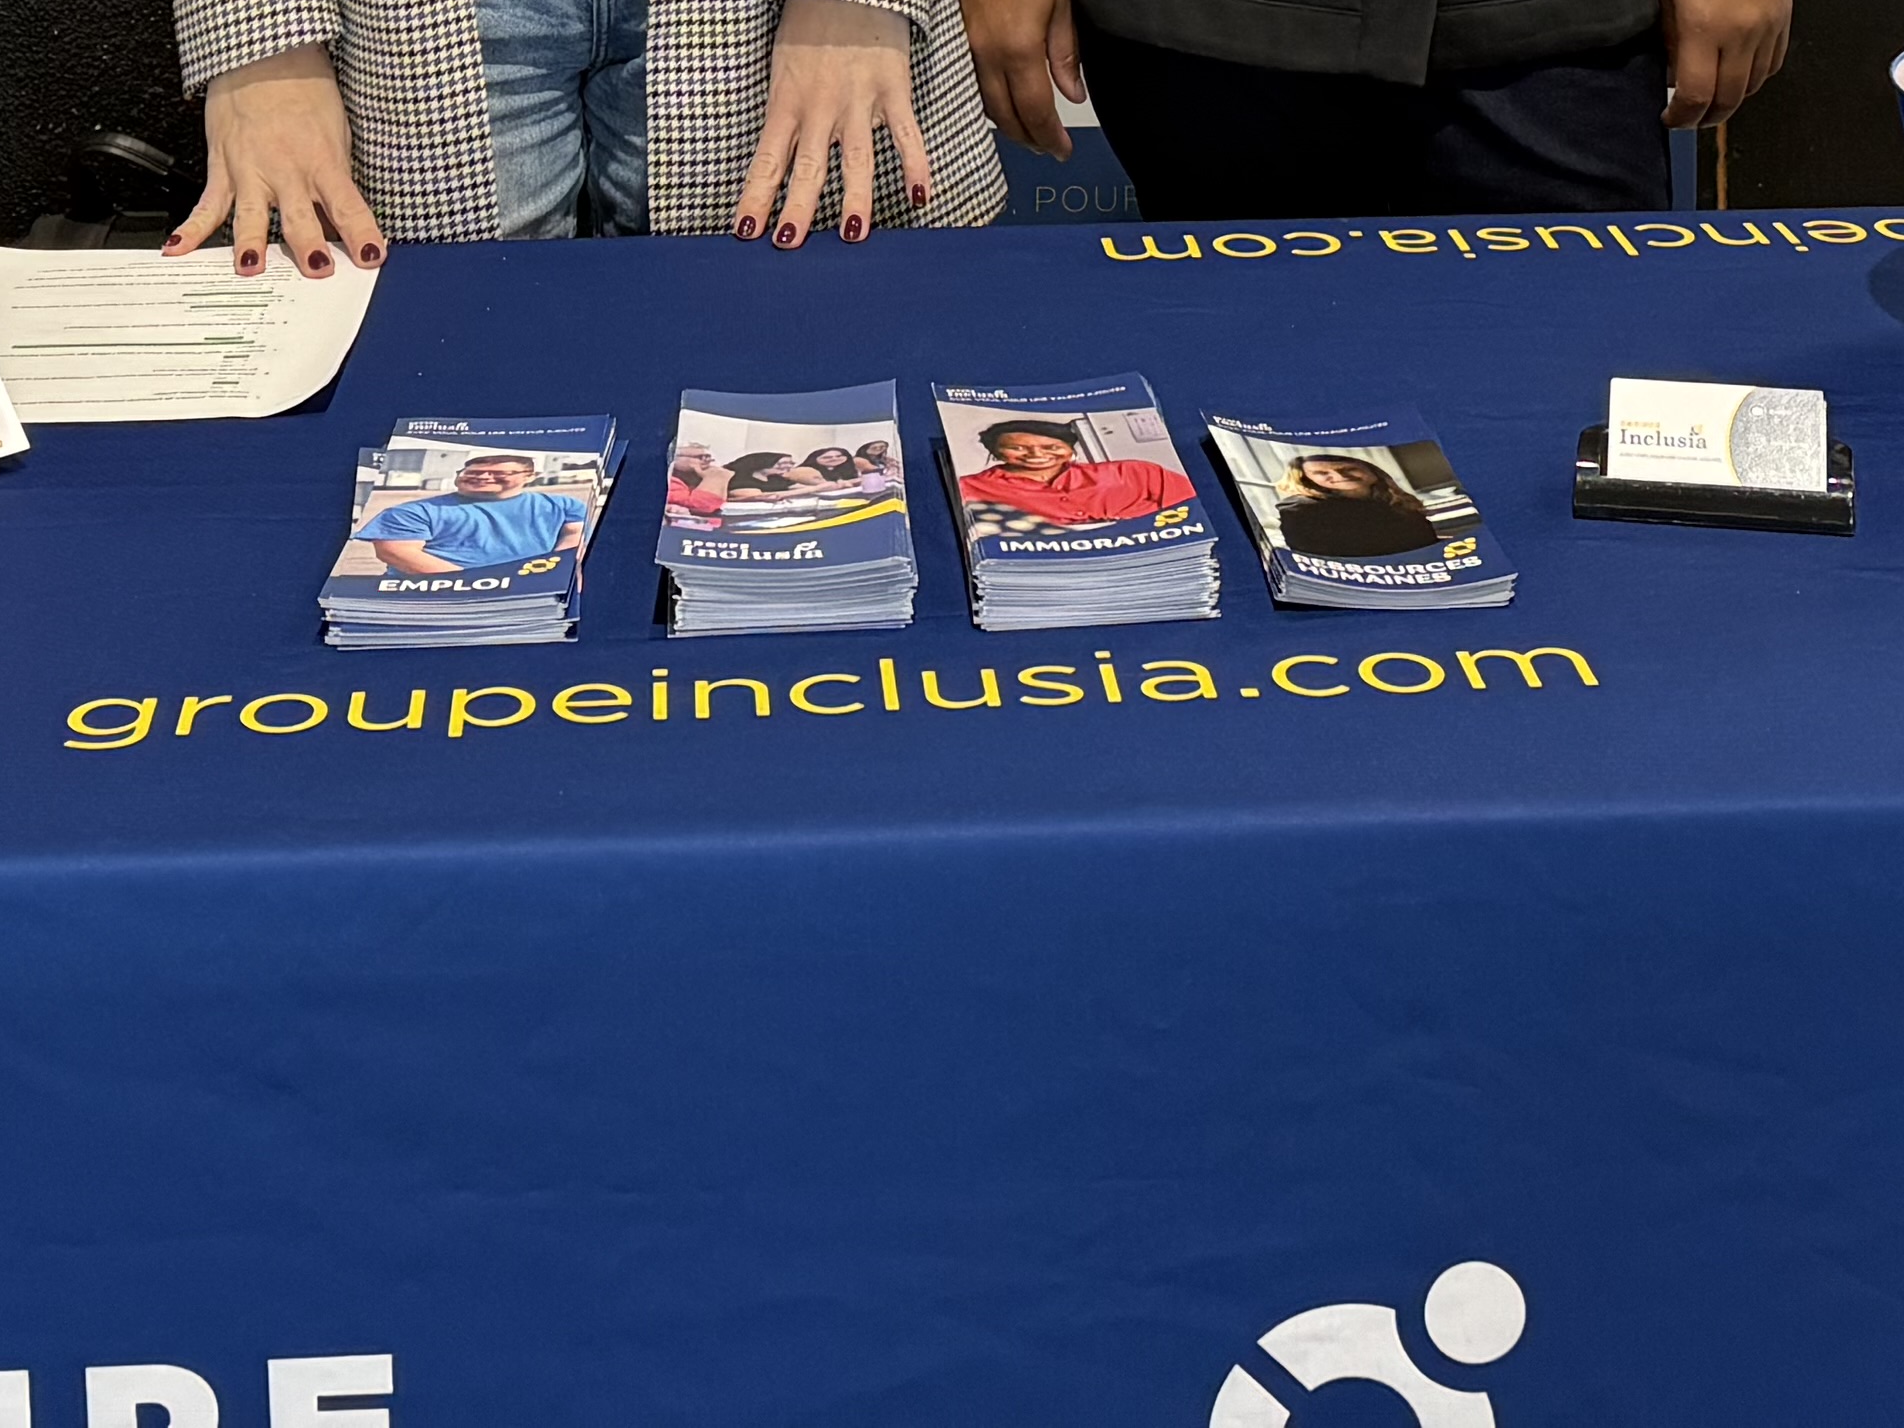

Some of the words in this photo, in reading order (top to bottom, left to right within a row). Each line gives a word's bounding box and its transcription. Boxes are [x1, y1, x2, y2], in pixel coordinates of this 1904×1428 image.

[1619, 428, 1707, 450] Inclusia
[999, 523, 1204, 553] IMMIGRATION
[1291, 552, 1482, 577] RESSOURCES
[1297, 563, 1452, 586] HUMAINES
[377, 574, 511, 595] EMPLOI
[61, 639, 1603, 751] groupeinclusia.com
